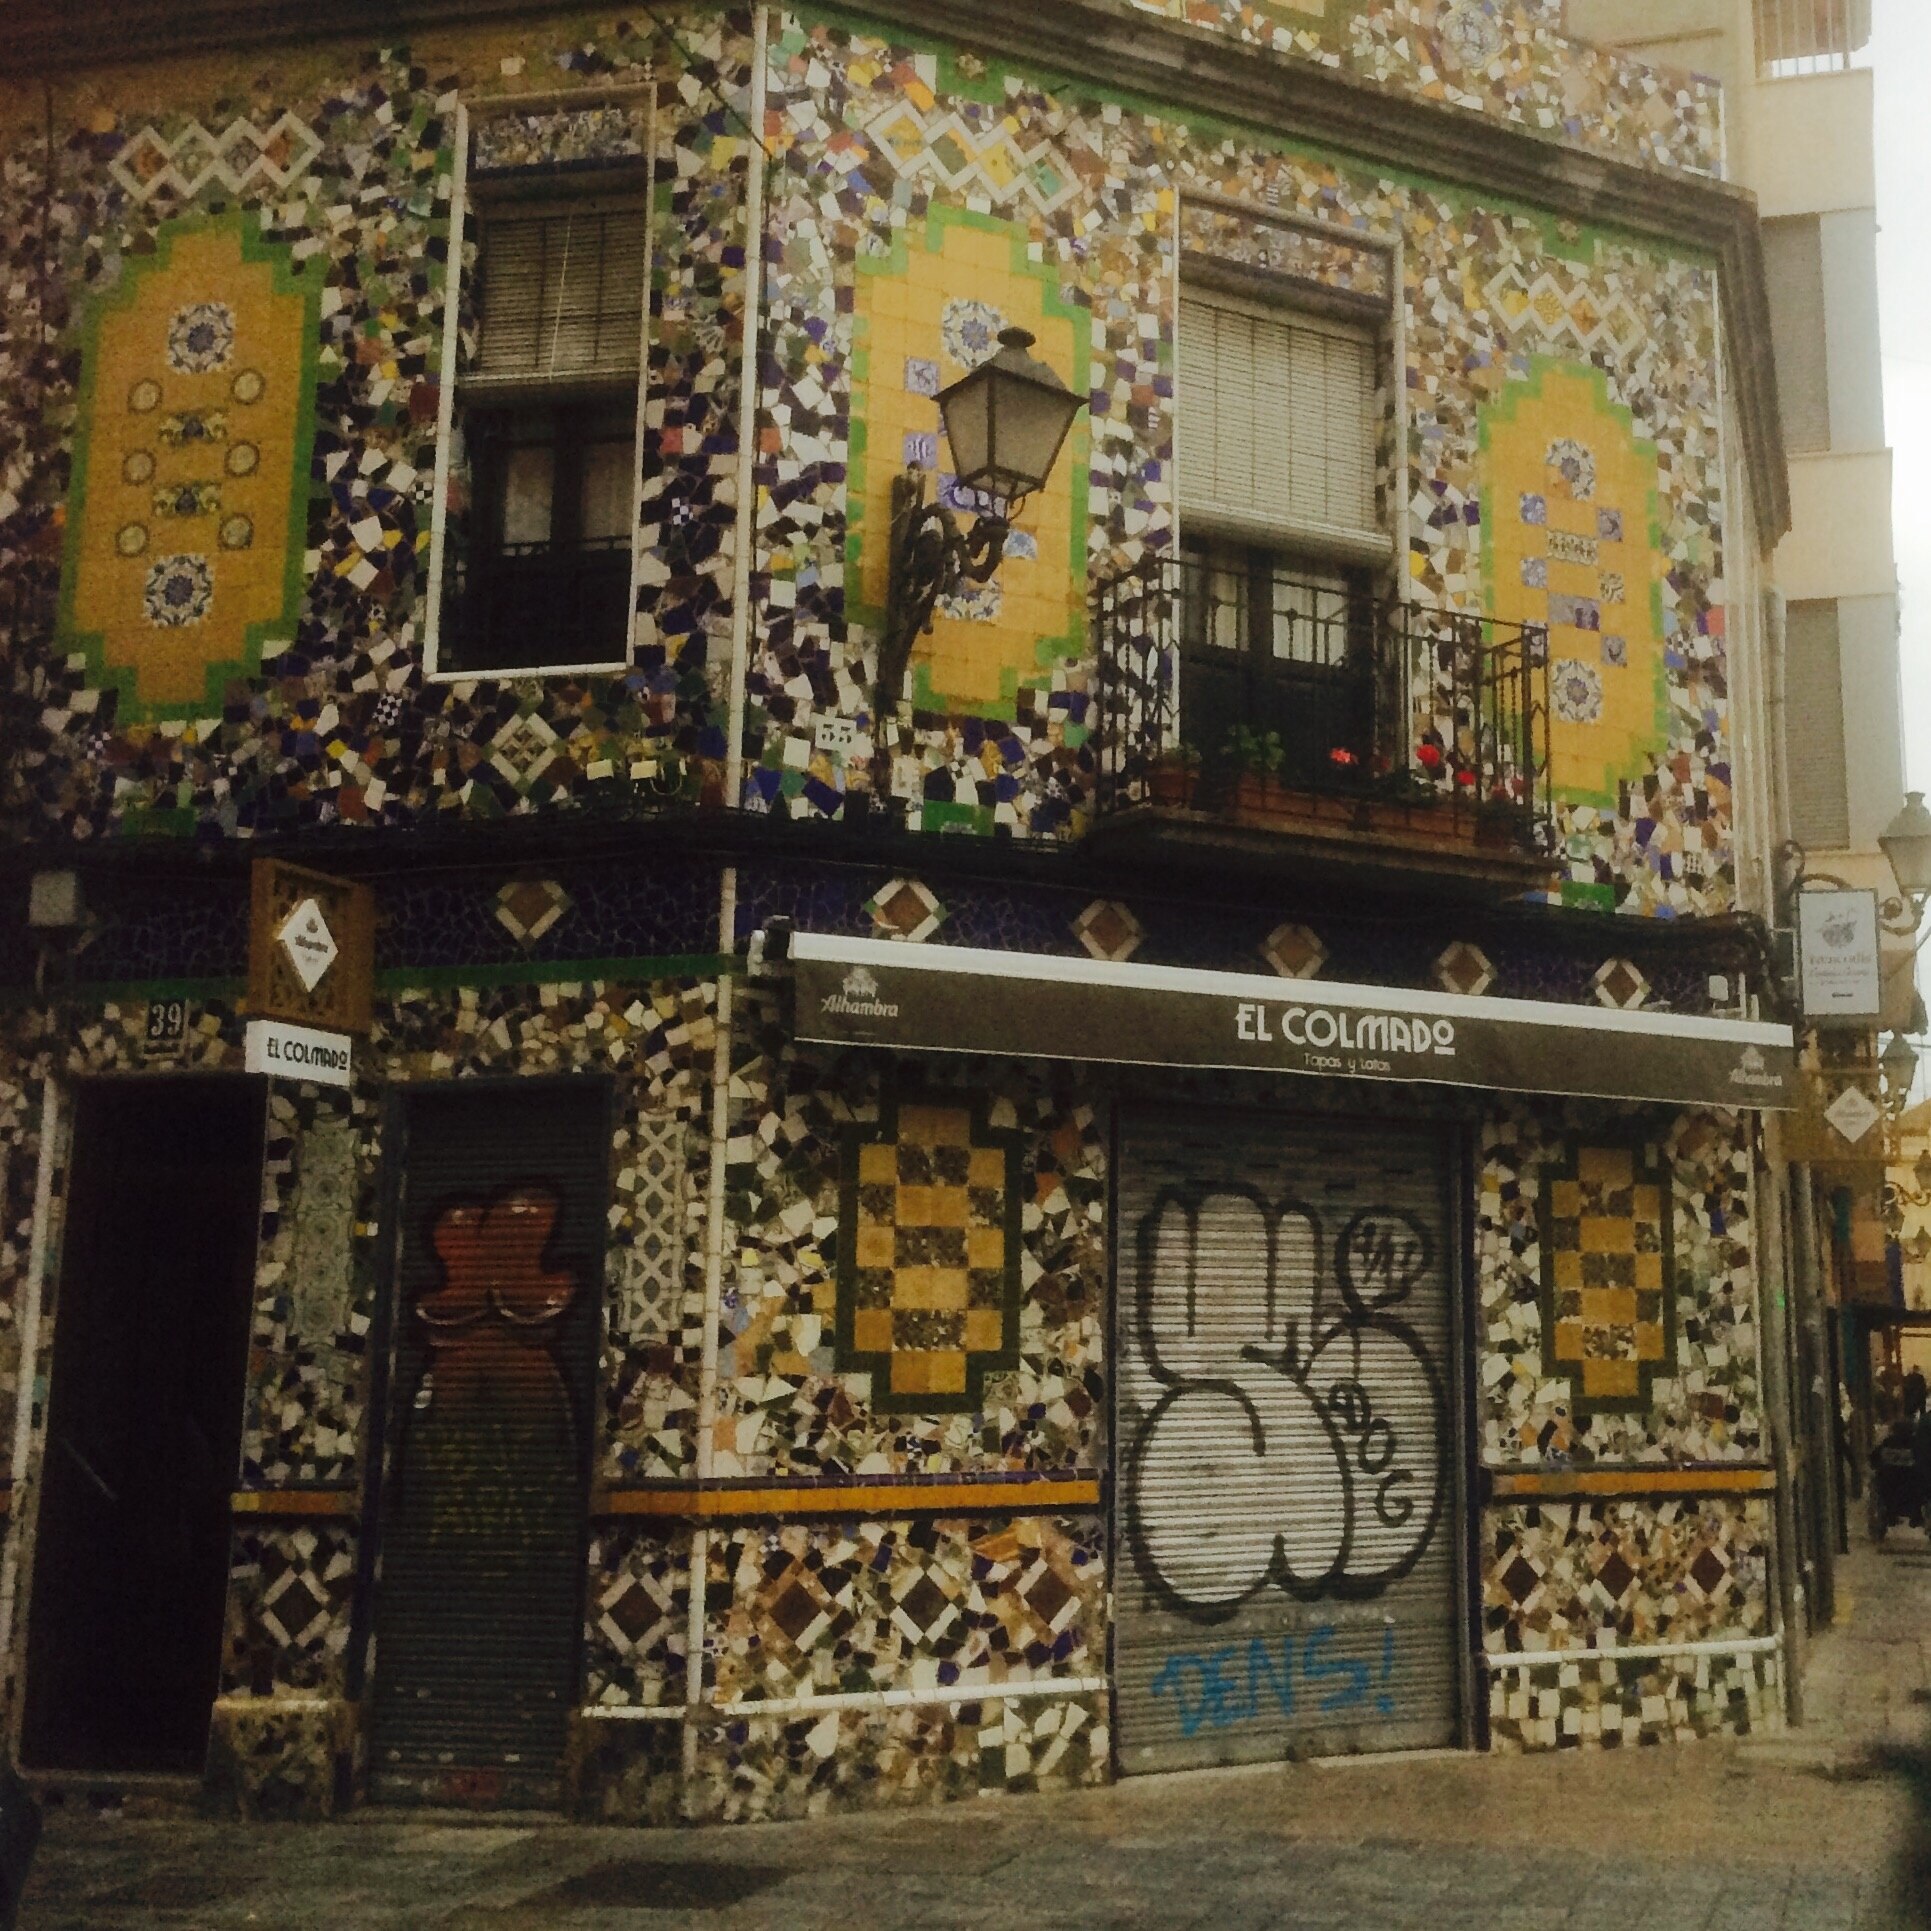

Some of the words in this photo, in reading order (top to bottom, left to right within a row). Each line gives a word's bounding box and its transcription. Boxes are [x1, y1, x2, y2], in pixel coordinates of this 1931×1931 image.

[151, 1002, 183, 1037] 39
[821, 994, 898, 1017] Alhambra
[1235, 1003, 1273, 1042] EL
[1281, 1007, 1456, 1056] COLMADO
[266, 1036, 281, 1059] EL
[283, 1041, 348, 1071] COLMADO
[1347, 1059, 1356, 1074] y
